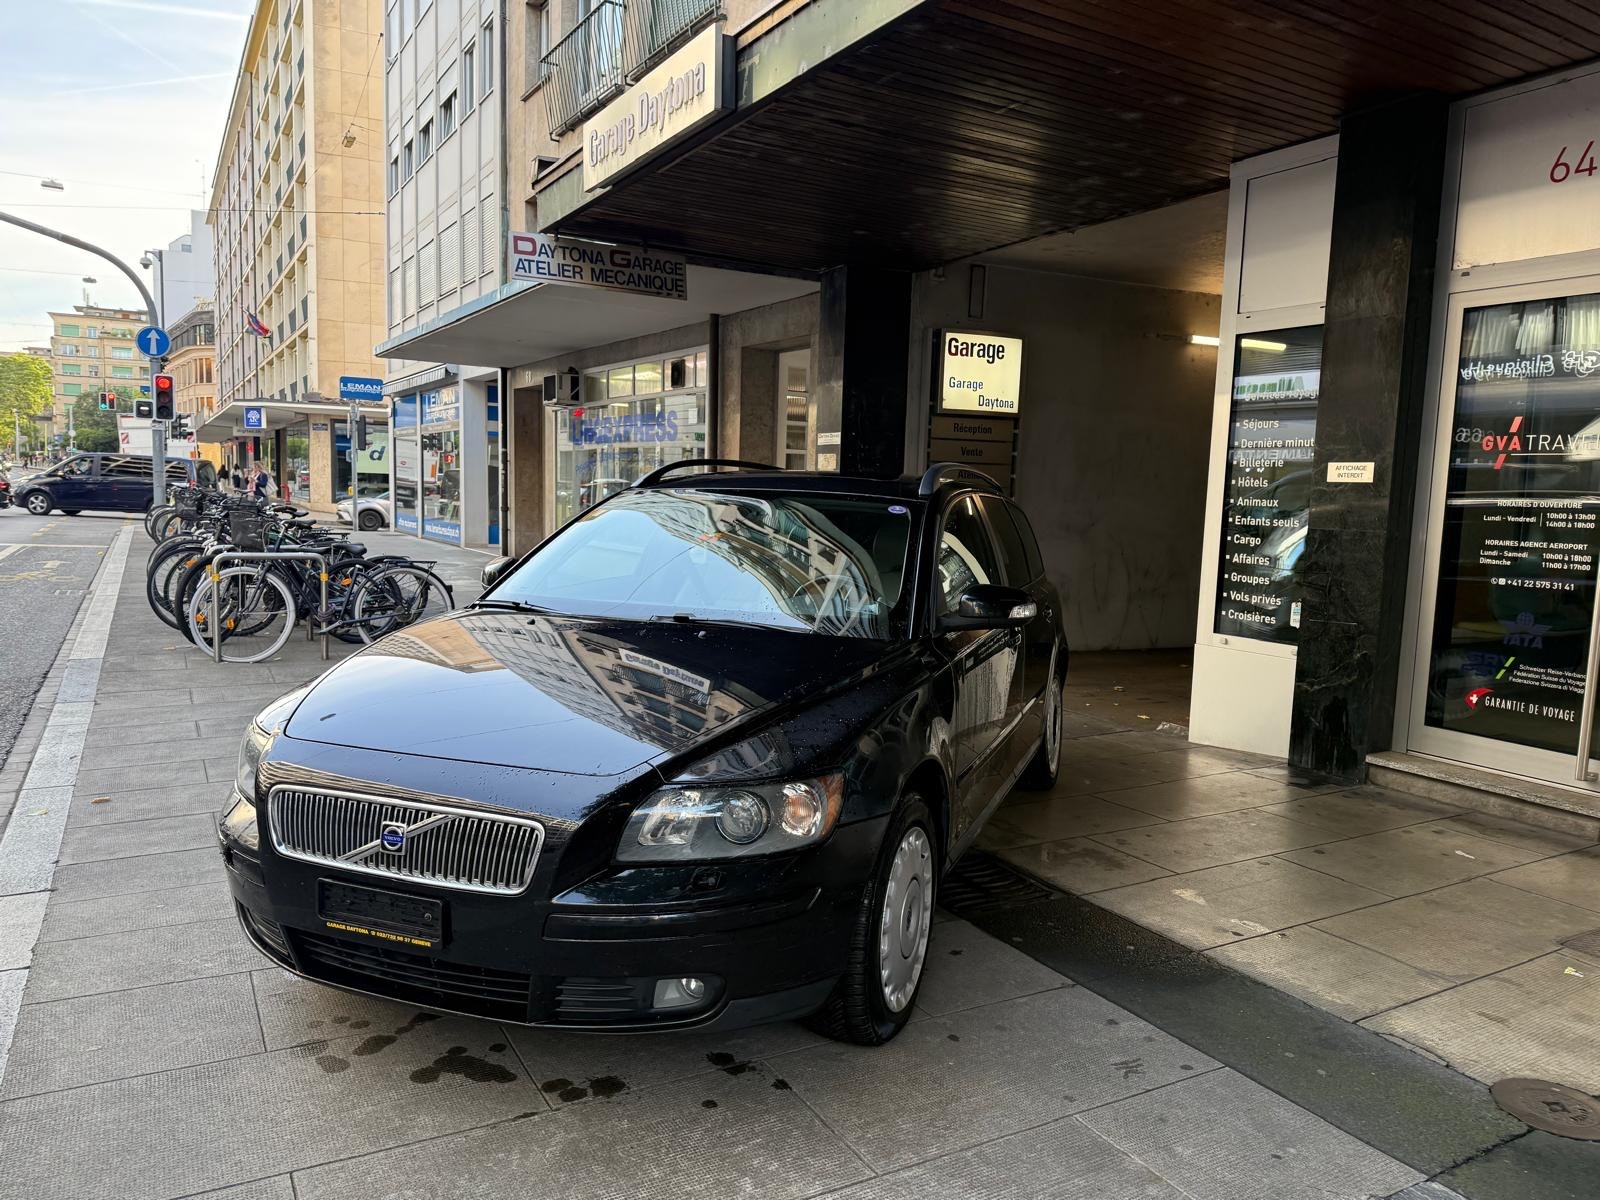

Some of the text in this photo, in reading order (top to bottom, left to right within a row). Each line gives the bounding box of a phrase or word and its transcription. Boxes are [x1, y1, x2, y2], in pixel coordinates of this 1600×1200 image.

[588, 61, 706, 168] Garage Daytona
[1550, 140, 1598, 183] 64
[512, 235, 684, 277] DAYTONA GARAGE
[514, 257, 685, 293] ATELIER MECANIQUE
[947, 337, 1006, 364] Garage
[340, 382, 381, 390] LEMAN
[948, 376, 984, 392] Garage
[978, 394, 1014, 409] Daytona
[953, 422, 993, 436] Réception
[1242, 418, 1280, 431] Séjours
[1240, 437, 1315, 449] Dernière minut
[1481, 435, 1521, 451] GVA
[960, 446, 984, 457] Vente
[1237, 476, 1269, 488] Hôtels
[1236, 496, 1279, 507] Animaux
[1497, 499, 1532, 508] HORAIRES
[1234, 515, 1300, 528] Enfants seuls
[1507, 515, 1537, 523] Vendredi
[1546, 512, 1567, 520] 10h00
[1575, 513, 1596, 521] 13h00
[1574, 521, 1595, 529] 18h00
[1233, 534, 1261, 546] Cargo
[1485, 539, 1588, 550] HORAIRES AGENCE AEROPORT
[1231, 553, 1270, 566] Affaires
[1503, 550, 1529, 558] Samedi
[1542, 552, 1563, 560] 10h00
[1570, 554, 1592, 563] 18h00
[1479, 557, 1511, 566] Dimanche
[1541, 561, 1562, 569] 11h00
[1570, 563, 1591, 571] 17h00
[1230, 572, 1270, 585] Groupes
[1535, 581, 1551, 589] 575
[1552, 582, 1562, 590] 31
[1564, 583, 1575, 591] 41
[1229, 591, 1282, 606] Vols privés
[1228, 609, 1277, 625] Croisières
[1513, 670, 1540, 679] Fédération
[1519, 664, 1546, 673] Schweizer
[1508, 676, 1540, 686] Federazione
[1540, 681, 1562, 690] Svizzera
[1568, 686, 1585, 694] Viagg
[1485, 696, 1575, 722] GARANTIE DE VOYAGE
[326, 921, 346, 930] GARAGE
[346, 925, 369, 935] DAYTONA
